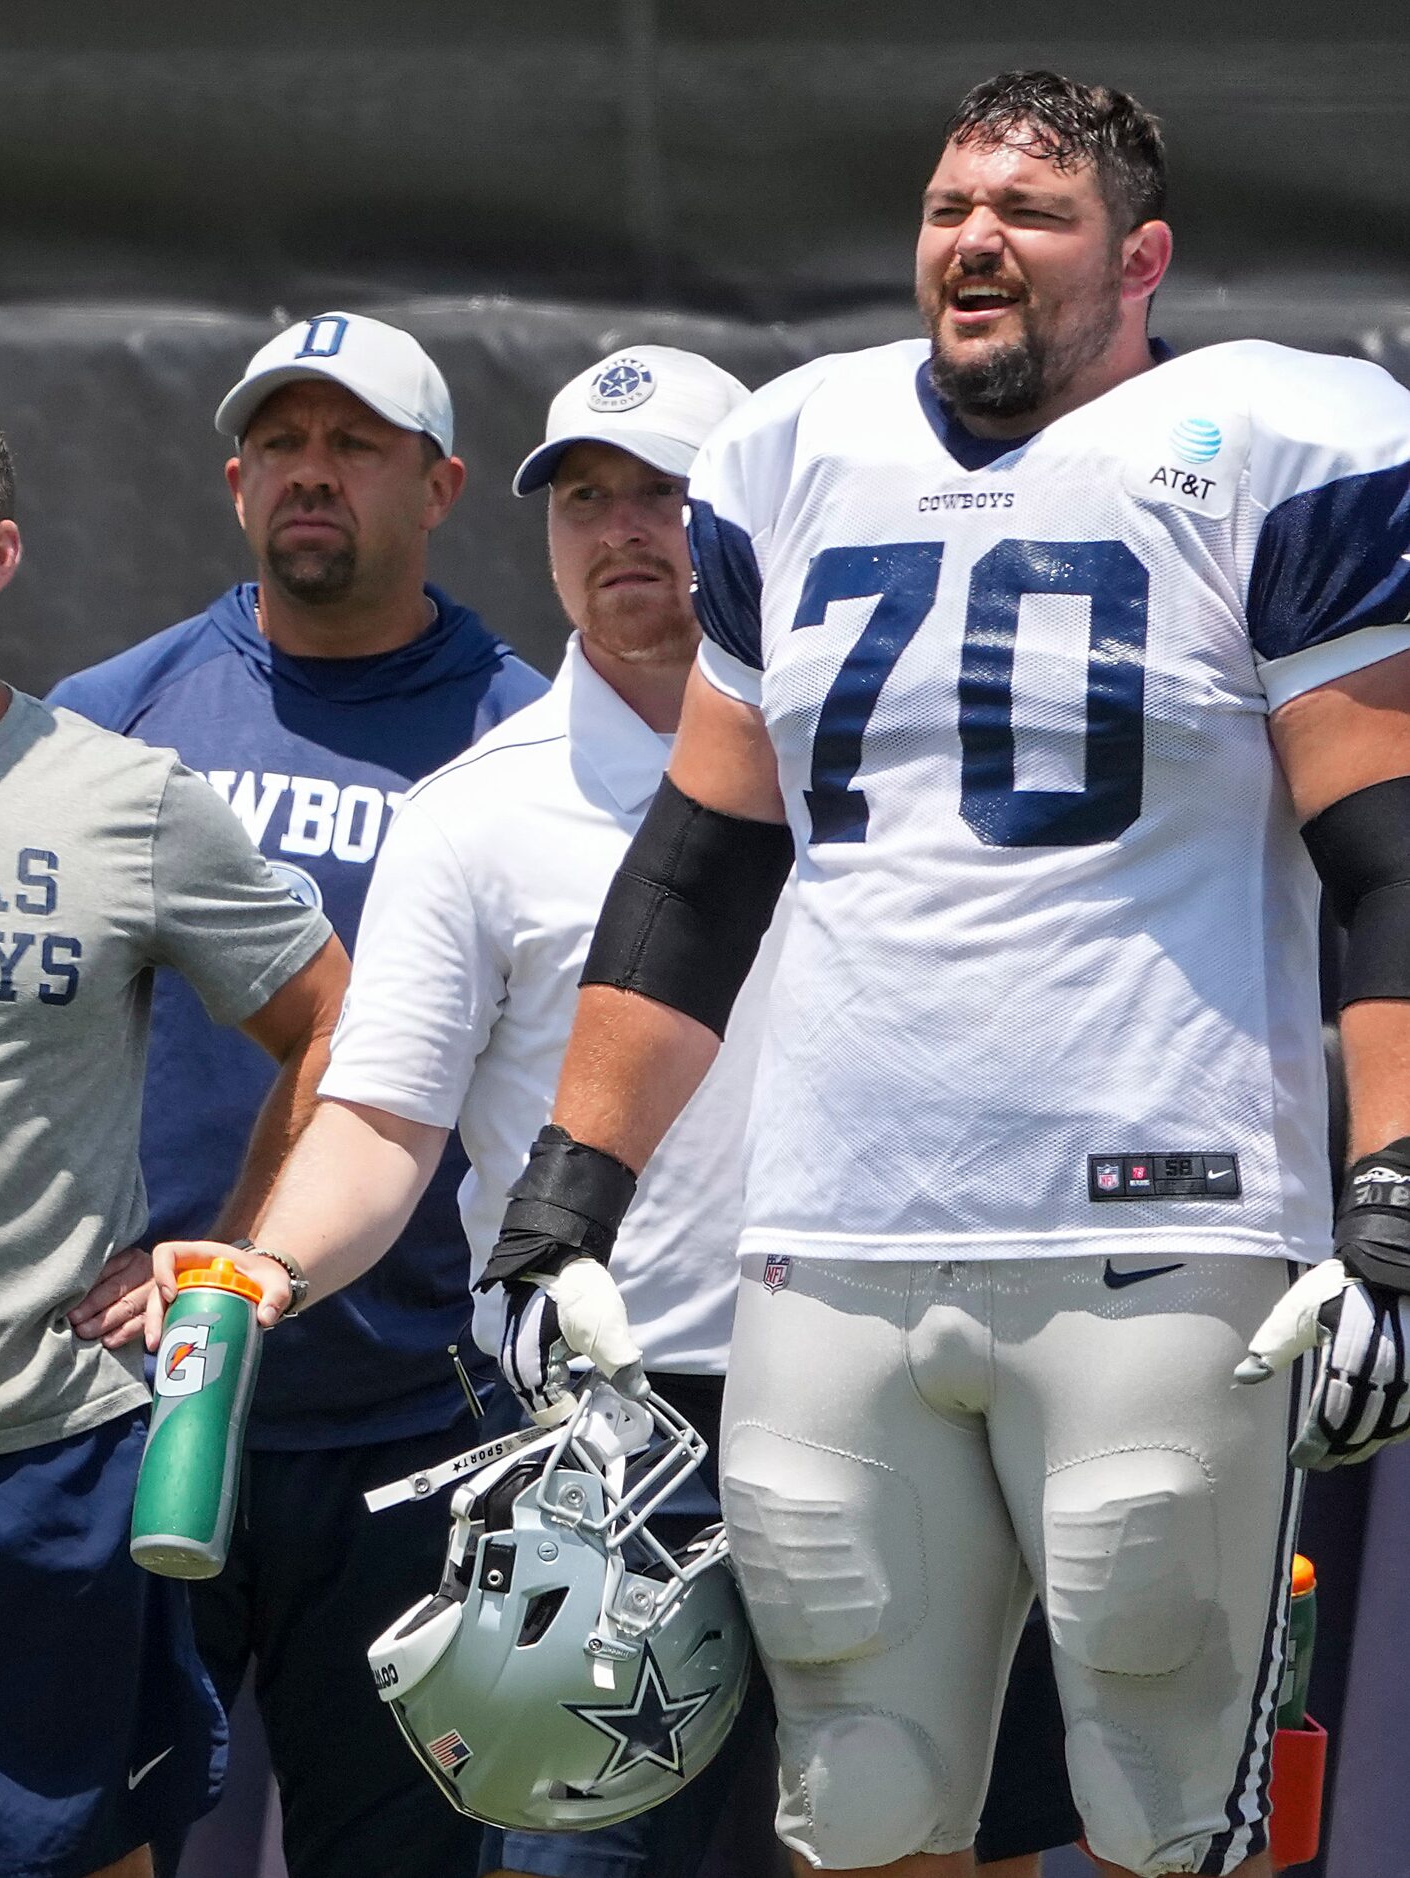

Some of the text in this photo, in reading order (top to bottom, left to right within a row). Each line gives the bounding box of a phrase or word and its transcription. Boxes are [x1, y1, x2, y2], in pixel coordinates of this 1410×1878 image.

[294, 315, 349, 360] D
[917, 492, 1015, 512] COWBOYS
[1149, 465, 1218, 501] AT&T
[791, 538, 1150, 848] 70
[193, 769, 408, 865] WBO
[155, 1323, 211, 1398] G
